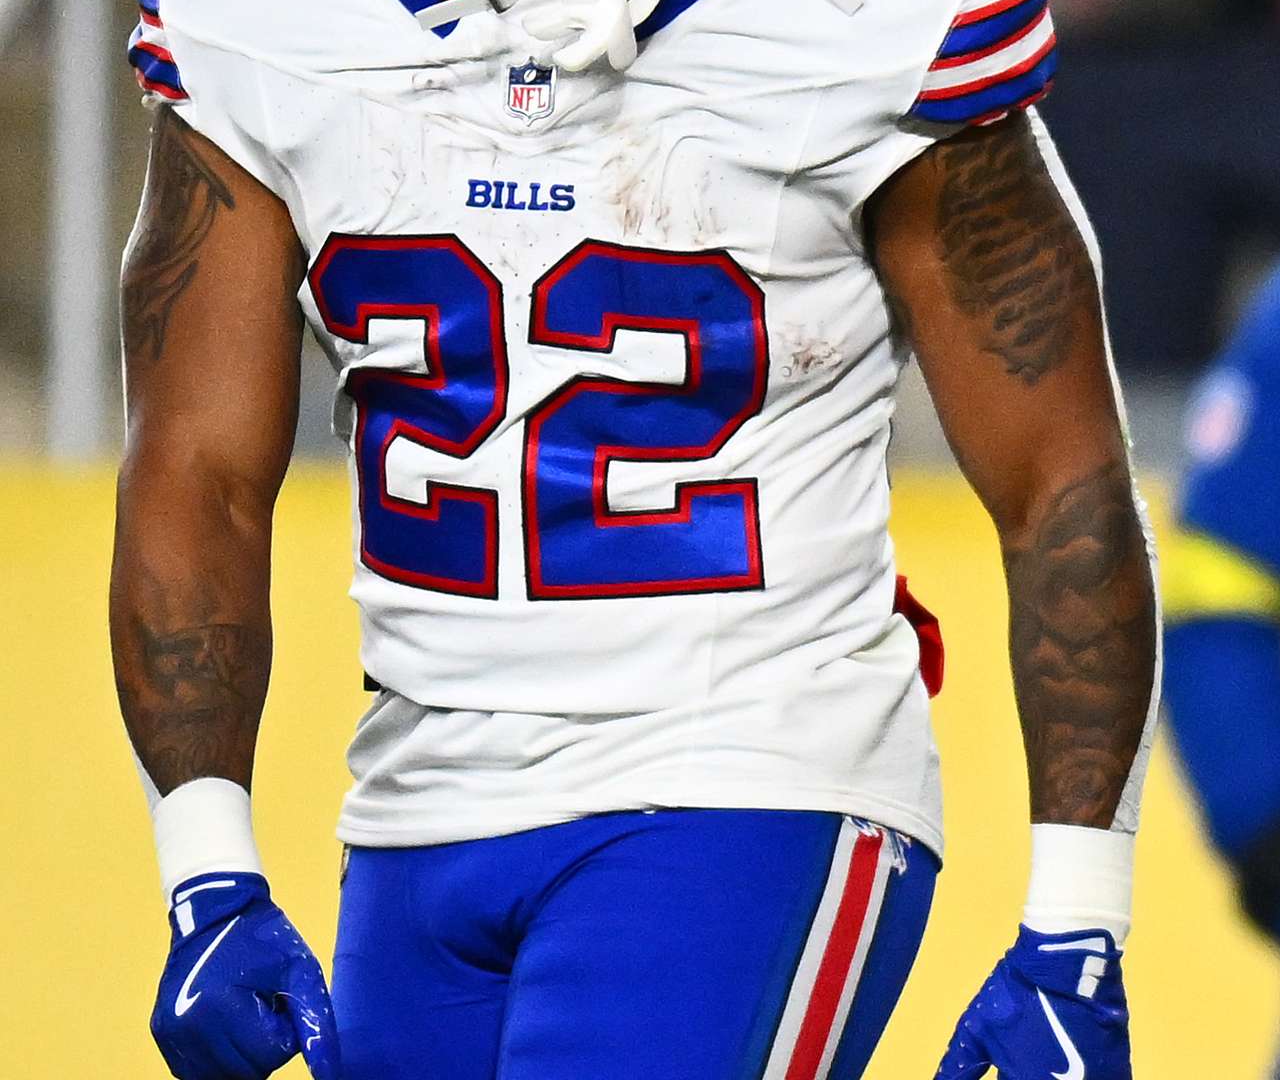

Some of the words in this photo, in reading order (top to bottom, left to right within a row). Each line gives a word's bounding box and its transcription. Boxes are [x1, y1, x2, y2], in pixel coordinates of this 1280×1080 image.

[511, 86, 546, 112] NFL
[465, 178, 576, 212] BILLS
[309, 232, 770, 601] 22
